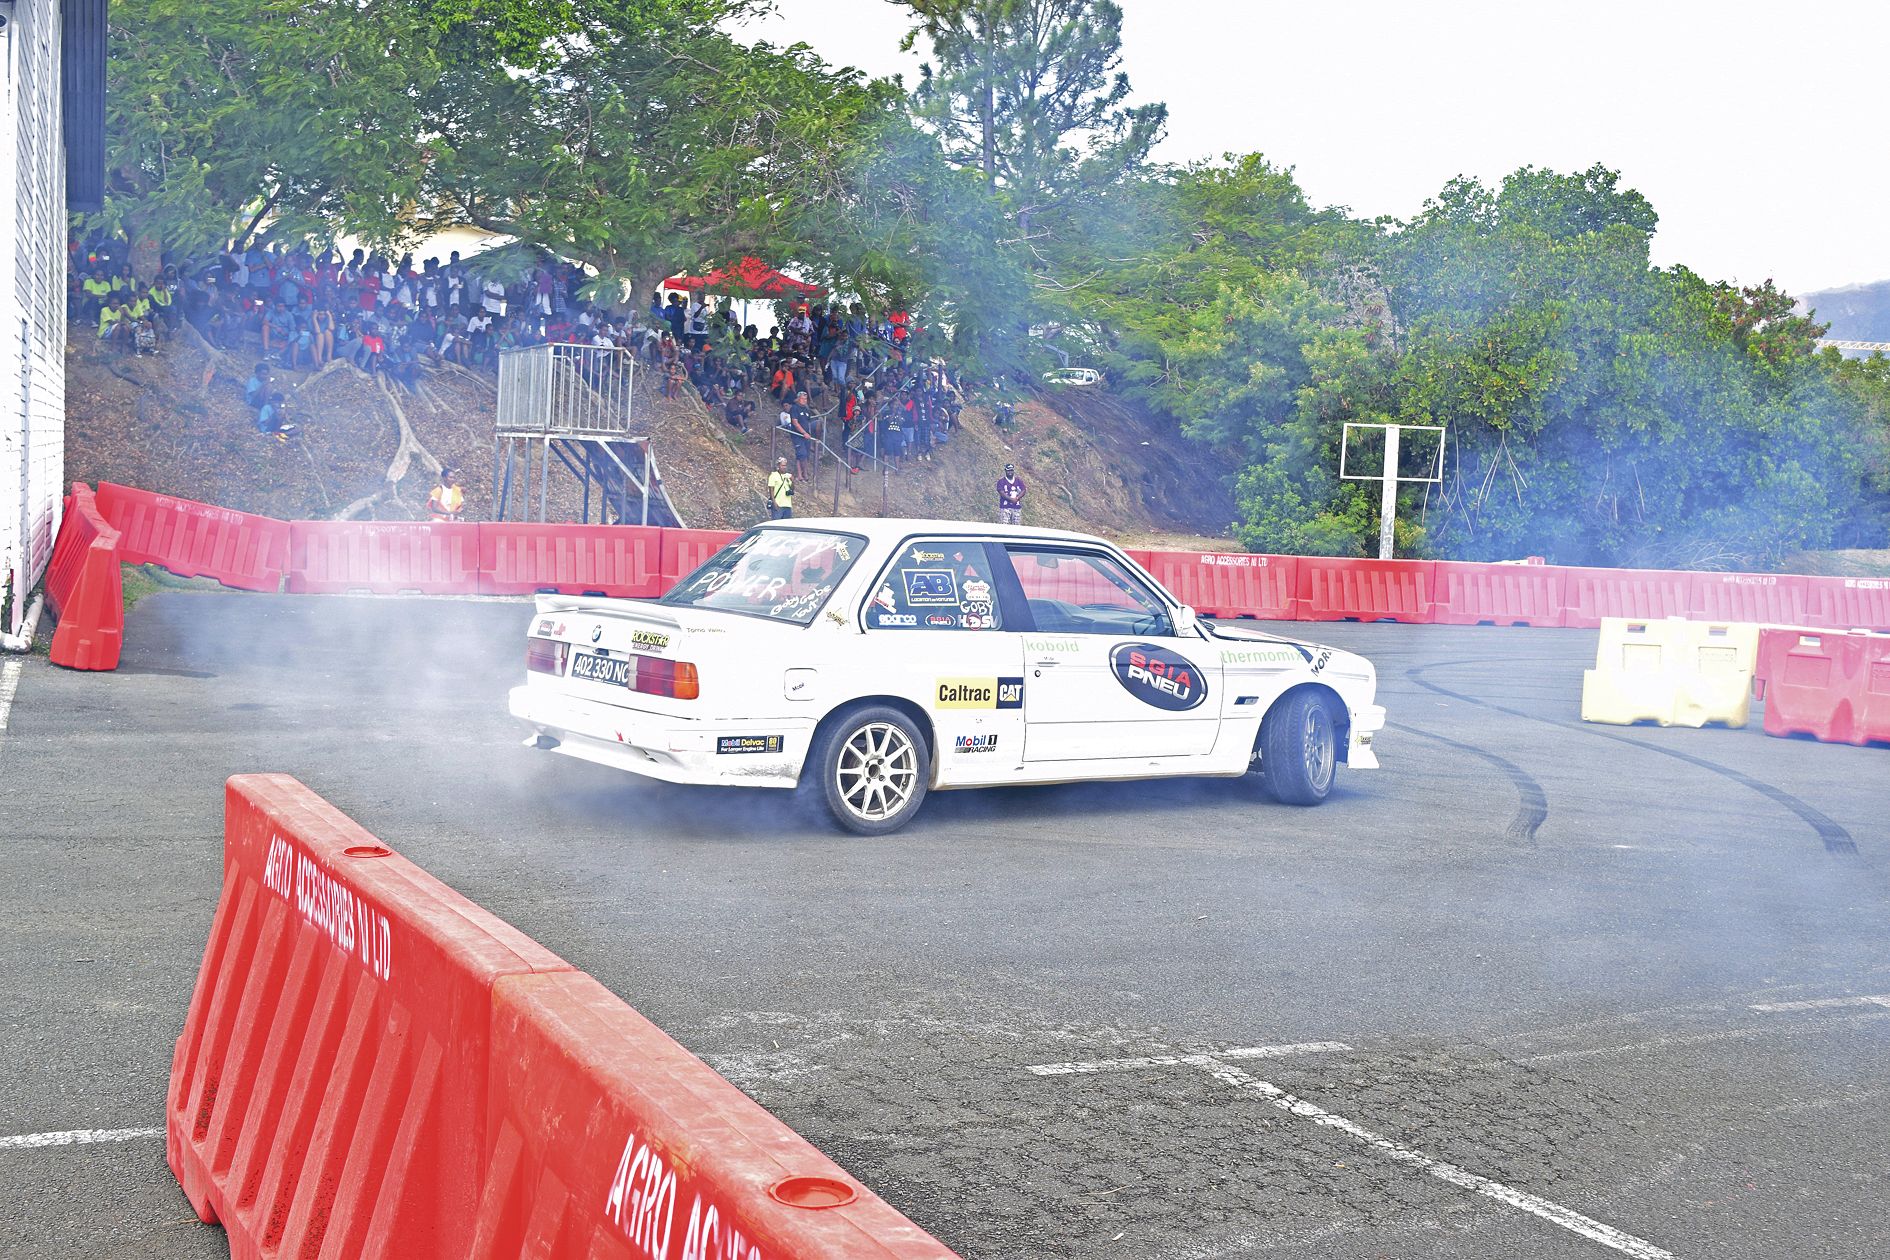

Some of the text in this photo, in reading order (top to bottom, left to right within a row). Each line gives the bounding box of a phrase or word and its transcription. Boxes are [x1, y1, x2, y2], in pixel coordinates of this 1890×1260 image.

[909, 572, 953, 596] AB
[1025, 639, 1080, 653] kobold
[1220, 650, 1305, 664] thermomix
[574, 655, 592, 677] 402
[592, 660, 613, 681] 330
[1129, 651, 1191, 688] SGIA
[1127, 664, 1190, 701] PNEU
[939, 684, 991, 702] Caltrac
[999, 683, 1024, 702] CAT
[741, 738, 765, 746] Delvac
[955, 735, 987, 747] Mobil
[968, 745, 996, 754] RACING
[263, 832, 293, 900] AGRO
[295, 851, 355, 952] ACCESSORIES
[371, 906, 391, 982] LTD
[604, 1132, 677, 1260] AGRO
